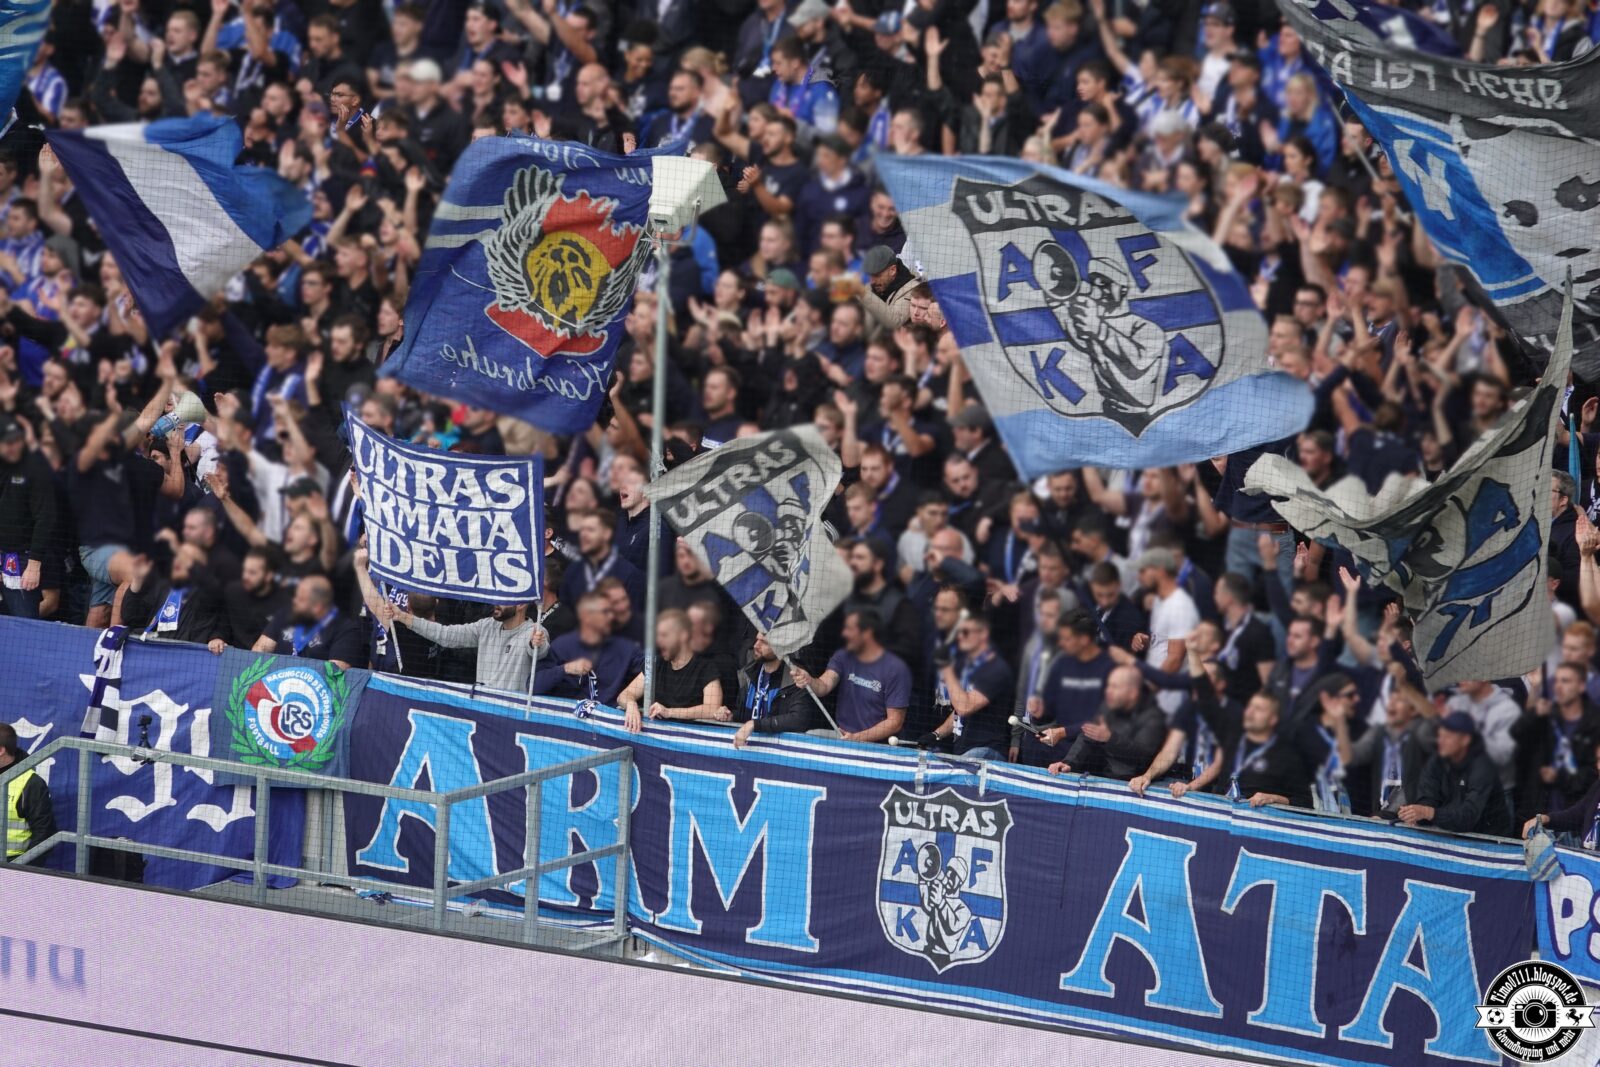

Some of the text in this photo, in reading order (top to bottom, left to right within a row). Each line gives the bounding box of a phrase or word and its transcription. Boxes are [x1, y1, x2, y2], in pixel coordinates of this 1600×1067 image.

[1452, 67, 1568, 110] MEHR
[965, 192, 1131, 226] ULTRA
[352, 423, 526, 510] ULTRAS
[666, 439, 797, 529] ULTRAS
[359, 474, 528, 552] ARMATA
[364, 516, 533, 594] IDELIS
[266, 670, 296, 682] RACING
[295, 670, 314, 682] CLUB
[311, 680, 323, 689] DE
[247, 717, 280, 756] FOOTBALL
[894, 801, 998, 837] ULTRAS
